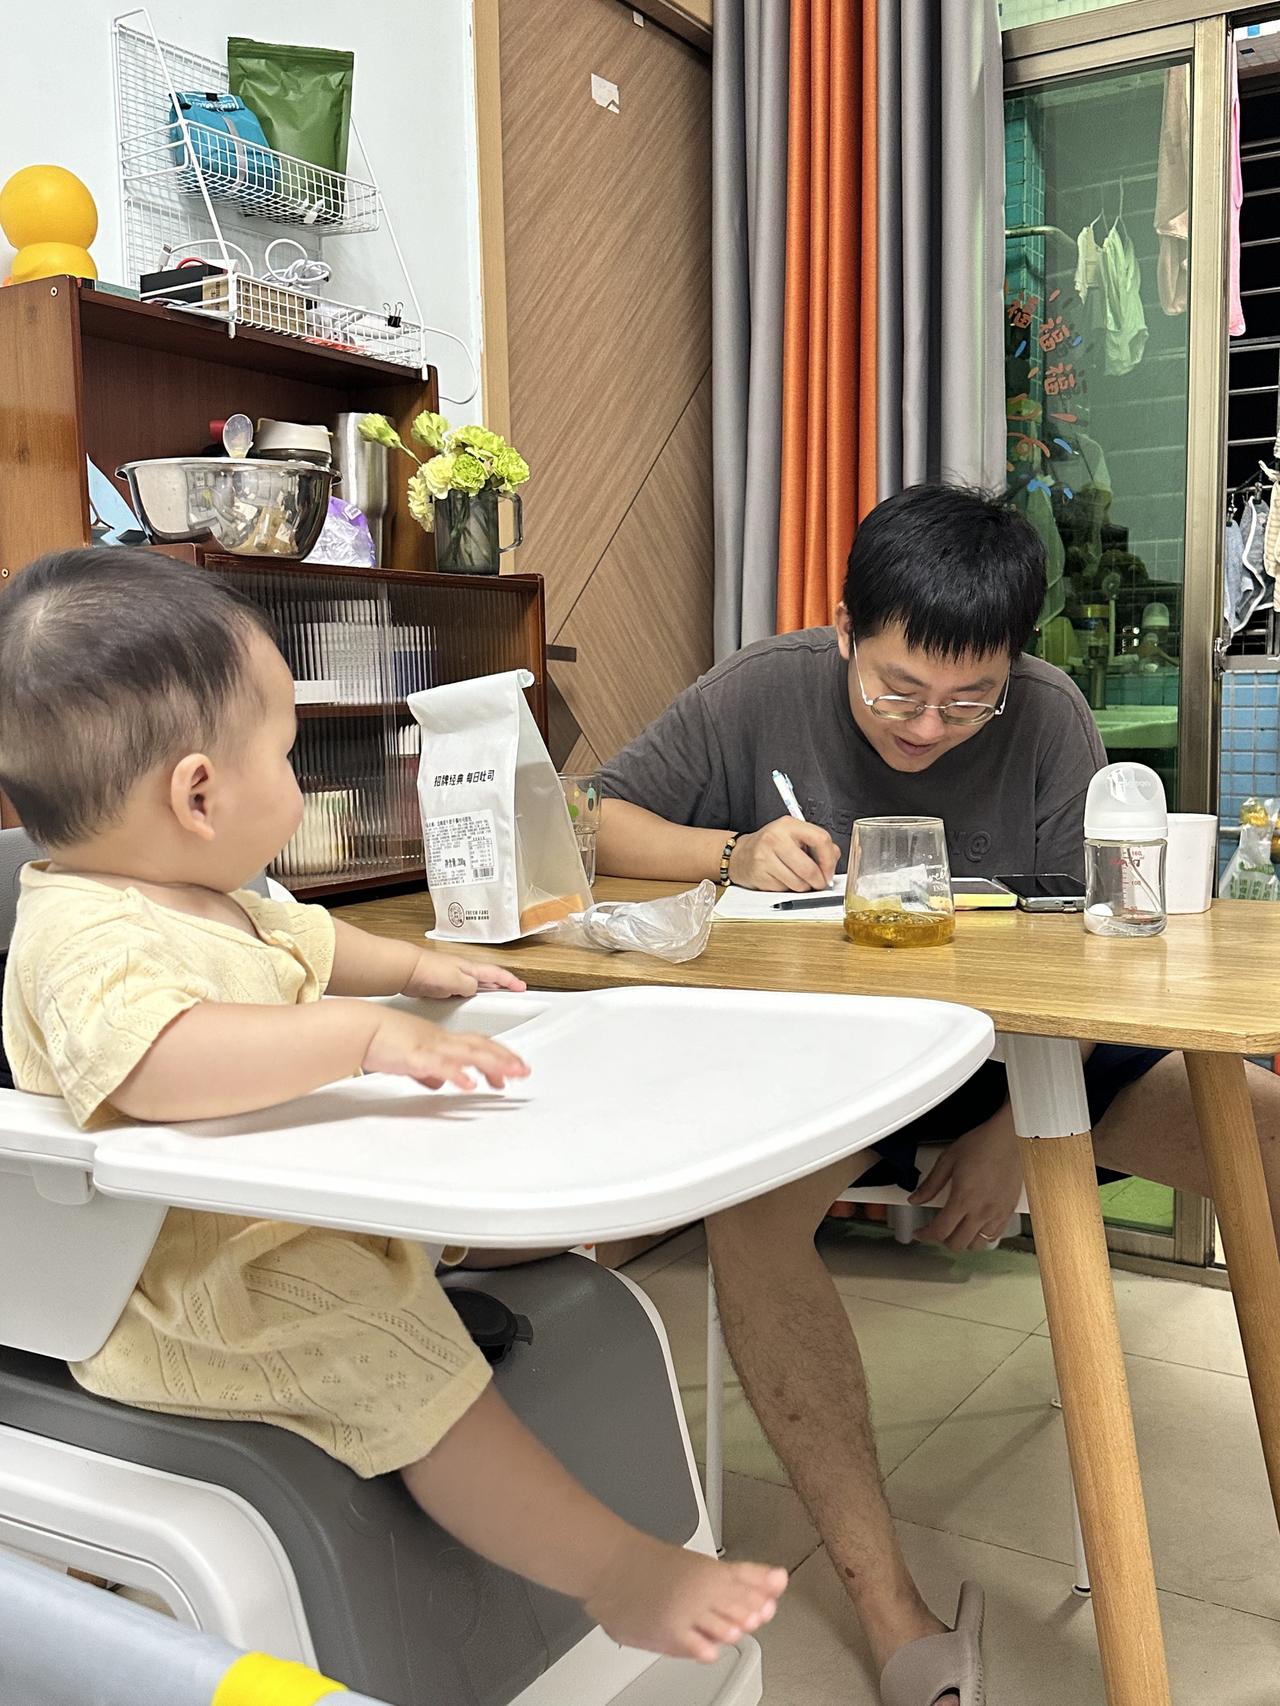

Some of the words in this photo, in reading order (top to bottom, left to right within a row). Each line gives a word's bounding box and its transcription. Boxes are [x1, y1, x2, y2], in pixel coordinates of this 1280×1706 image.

[434, 774, 464, 787] 招牌经典
[466, 769, 495, 784] 每日吐司
